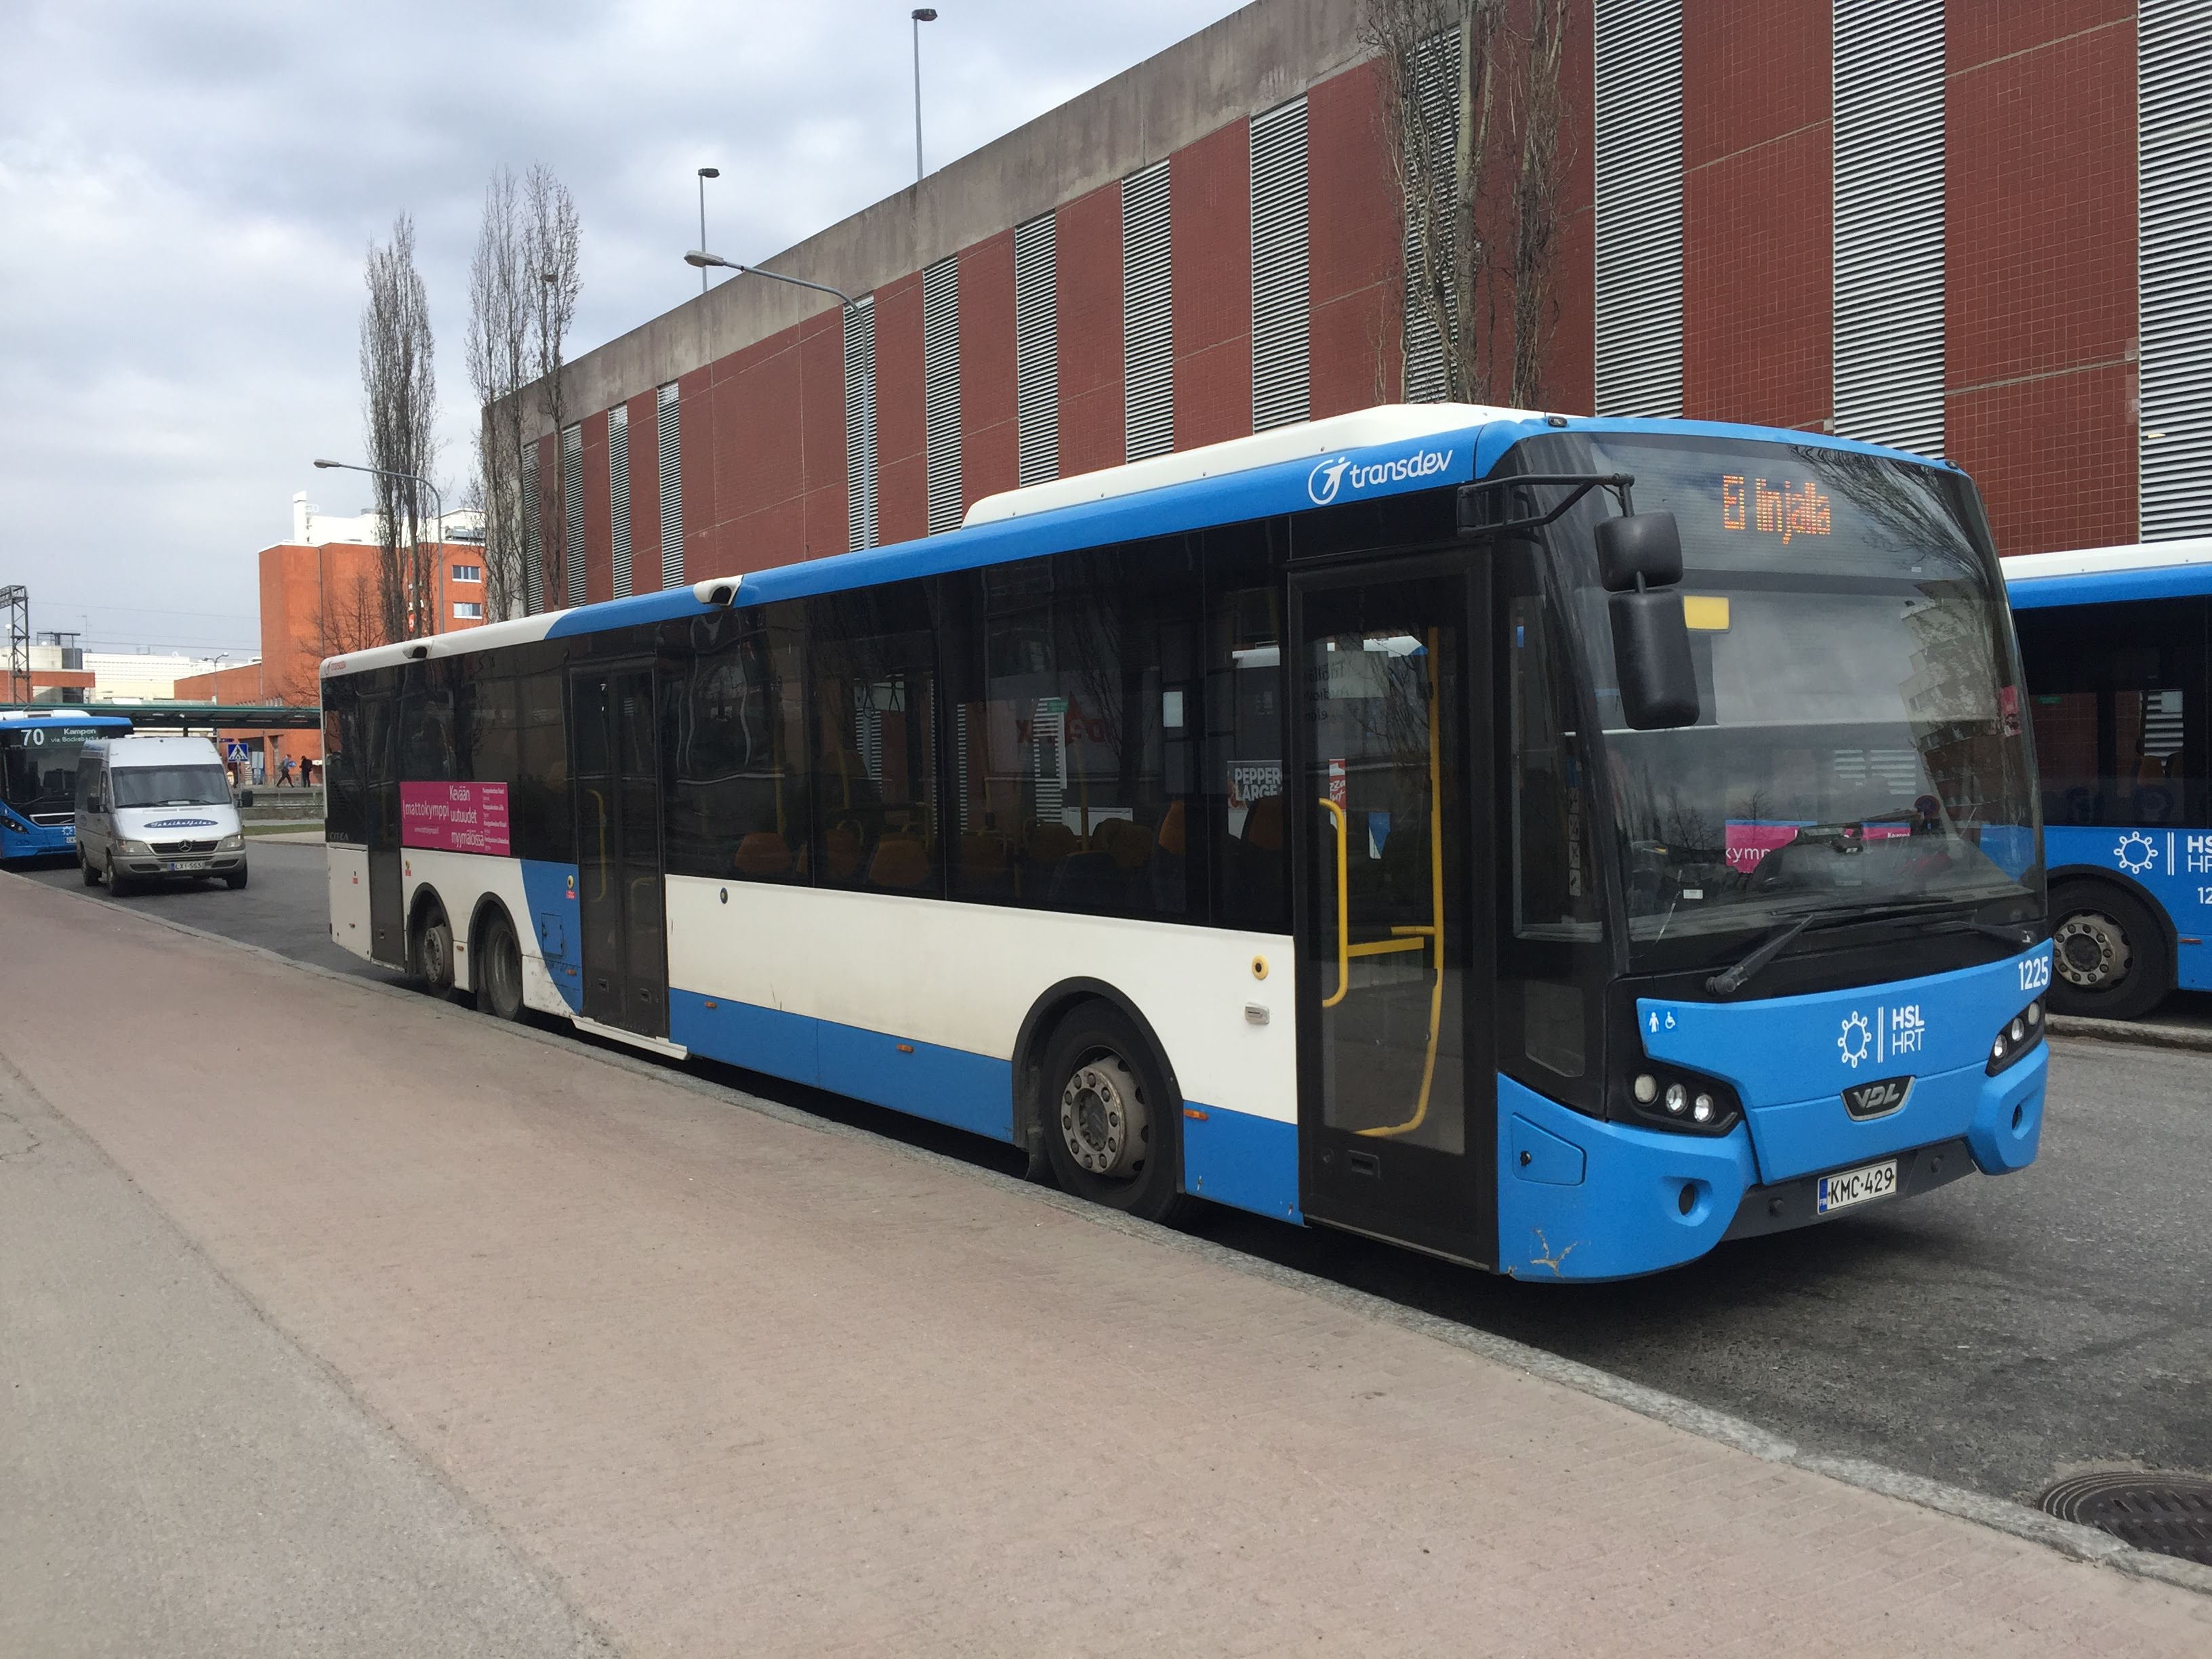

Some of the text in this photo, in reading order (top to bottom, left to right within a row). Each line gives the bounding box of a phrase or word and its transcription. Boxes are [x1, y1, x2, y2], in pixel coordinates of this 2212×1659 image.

[1350, 450, 1453, 488] transdev
[21, 729, 44, 745] 70
[1235, 767, 1281, 784] PEPPER
[449, 785, 470, 801] Kevään
[450, 807, 477, 824] uutuudet
[2018, 956, 2048, 991] 1225
[1892, 1004, 1925, 1031] HSL
[1892, 1028, 1925, 1055] HRT
[1853, 1084, 1900, 1108] VDL
[1830, 1167, 1893, 1204] KMC-429
